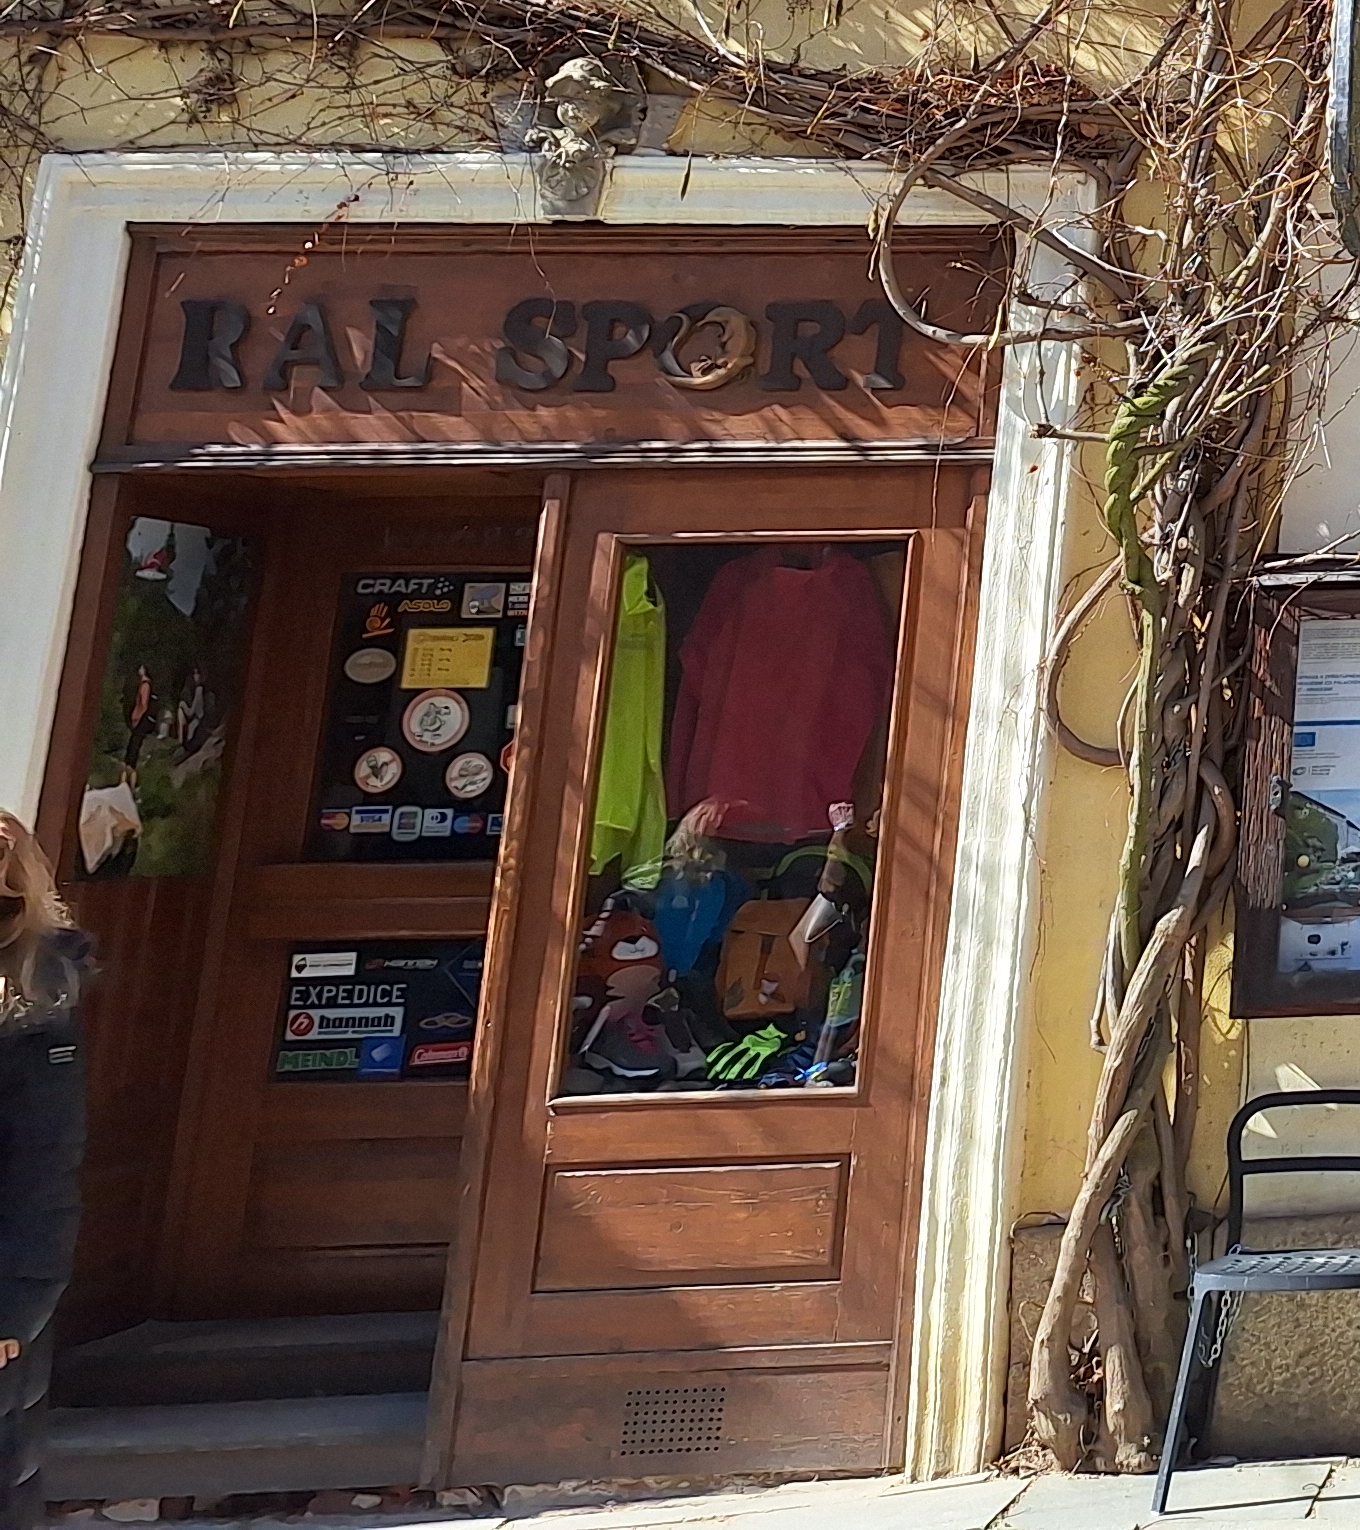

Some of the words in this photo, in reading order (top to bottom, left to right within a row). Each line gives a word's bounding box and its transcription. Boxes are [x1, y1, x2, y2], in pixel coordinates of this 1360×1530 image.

[170, 295, 434, 392] RAL
[494, 295, 905, 397] SPORT
[355, 578, 435, 595] CRAFT
[397, 599, 452, 613] ASOLO
[289, 983, 408, 1006] EXPEDICE
[318, 1013, 395, 1029] hannah
[278, 1048, 360, 1070] MEINDL
